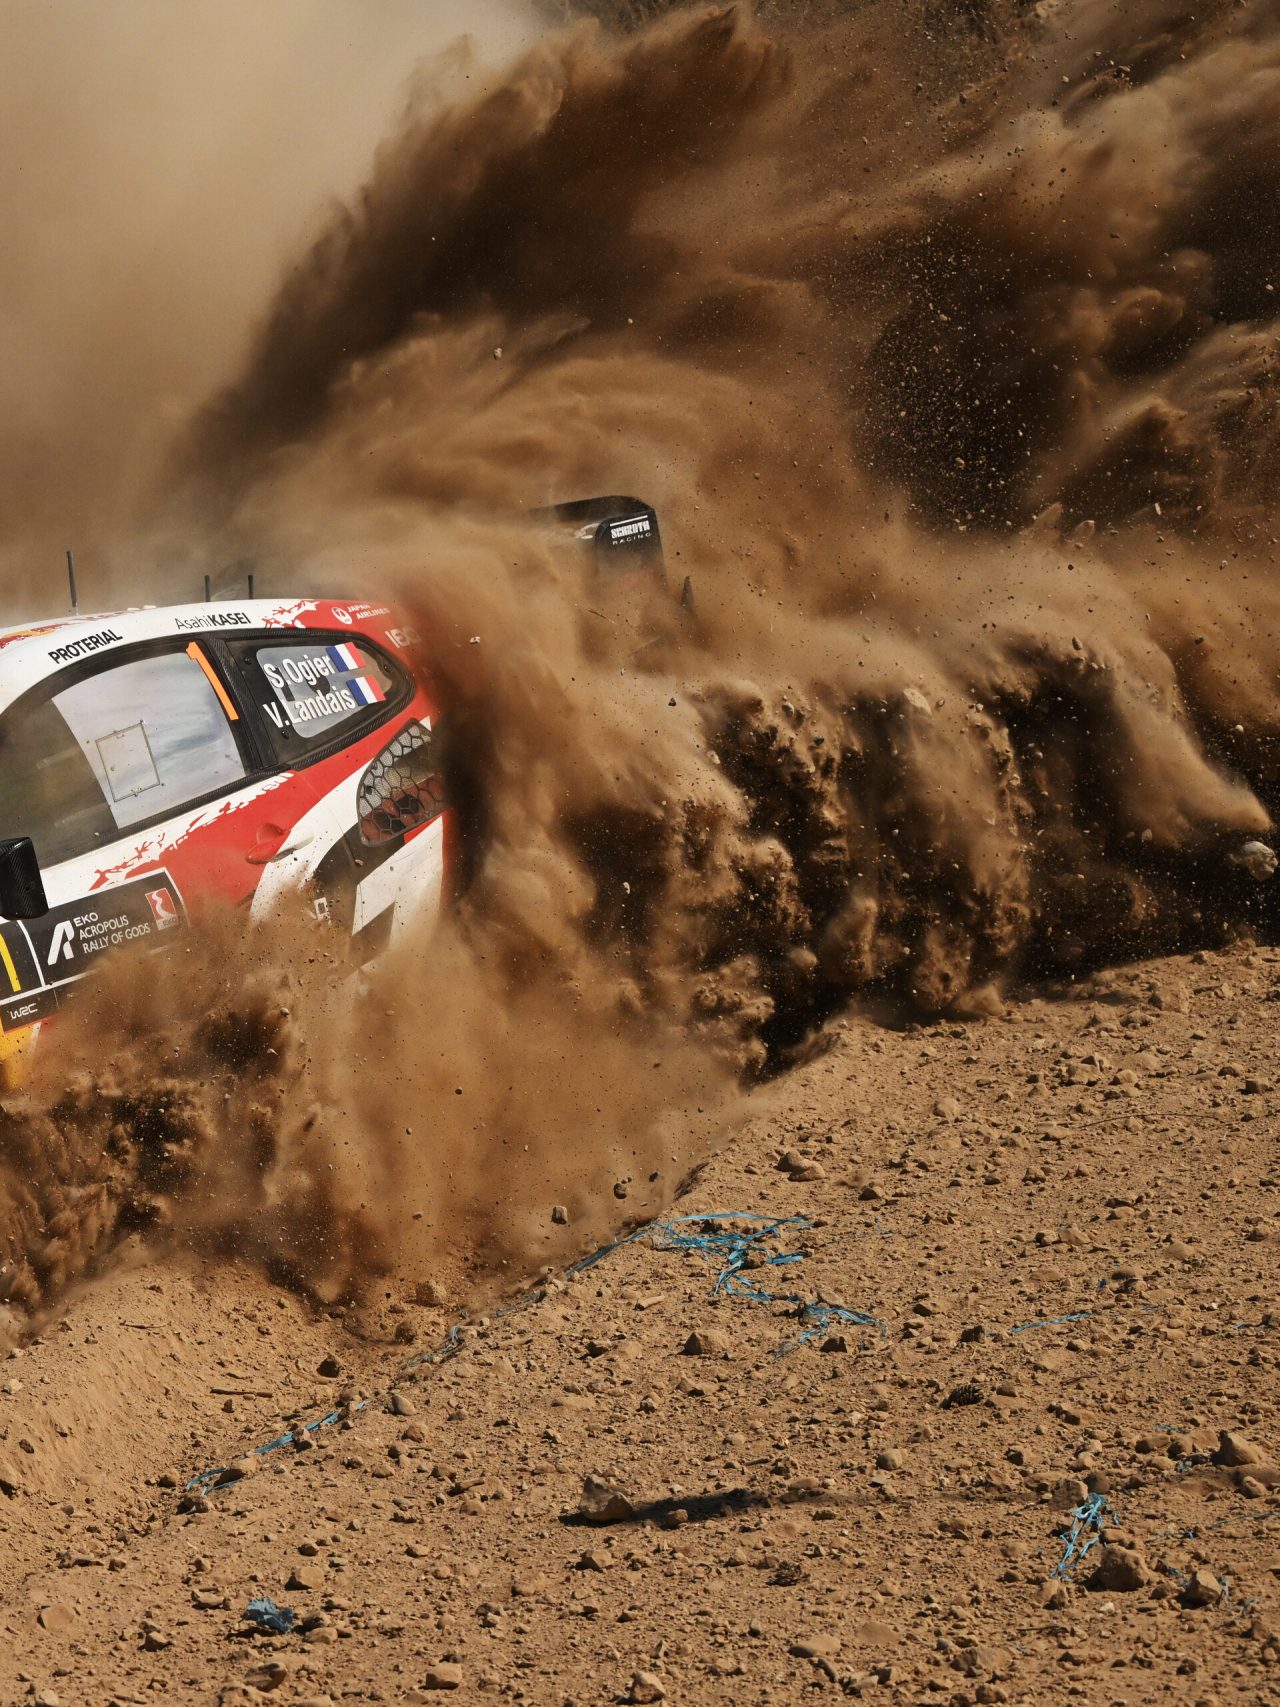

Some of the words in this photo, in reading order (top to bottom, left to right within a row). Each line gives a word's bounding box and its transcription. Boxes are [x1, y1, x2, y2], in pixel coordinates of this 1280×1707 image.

[612, 532, 652, 545] RACING
[356, 607, 391, 620] AIRLINES
[48, 629, 123, 664] PROTERIAL
[73, 912, 99, 927] EKO
[79, 914, 129, 940] ACROPOLIS
[82, 936, 109, 954] RALLY
[111, 931, 124, 945] OF
[125, 922, 151, 940] GODS
[9, 1002, 38, 1020] WRC
